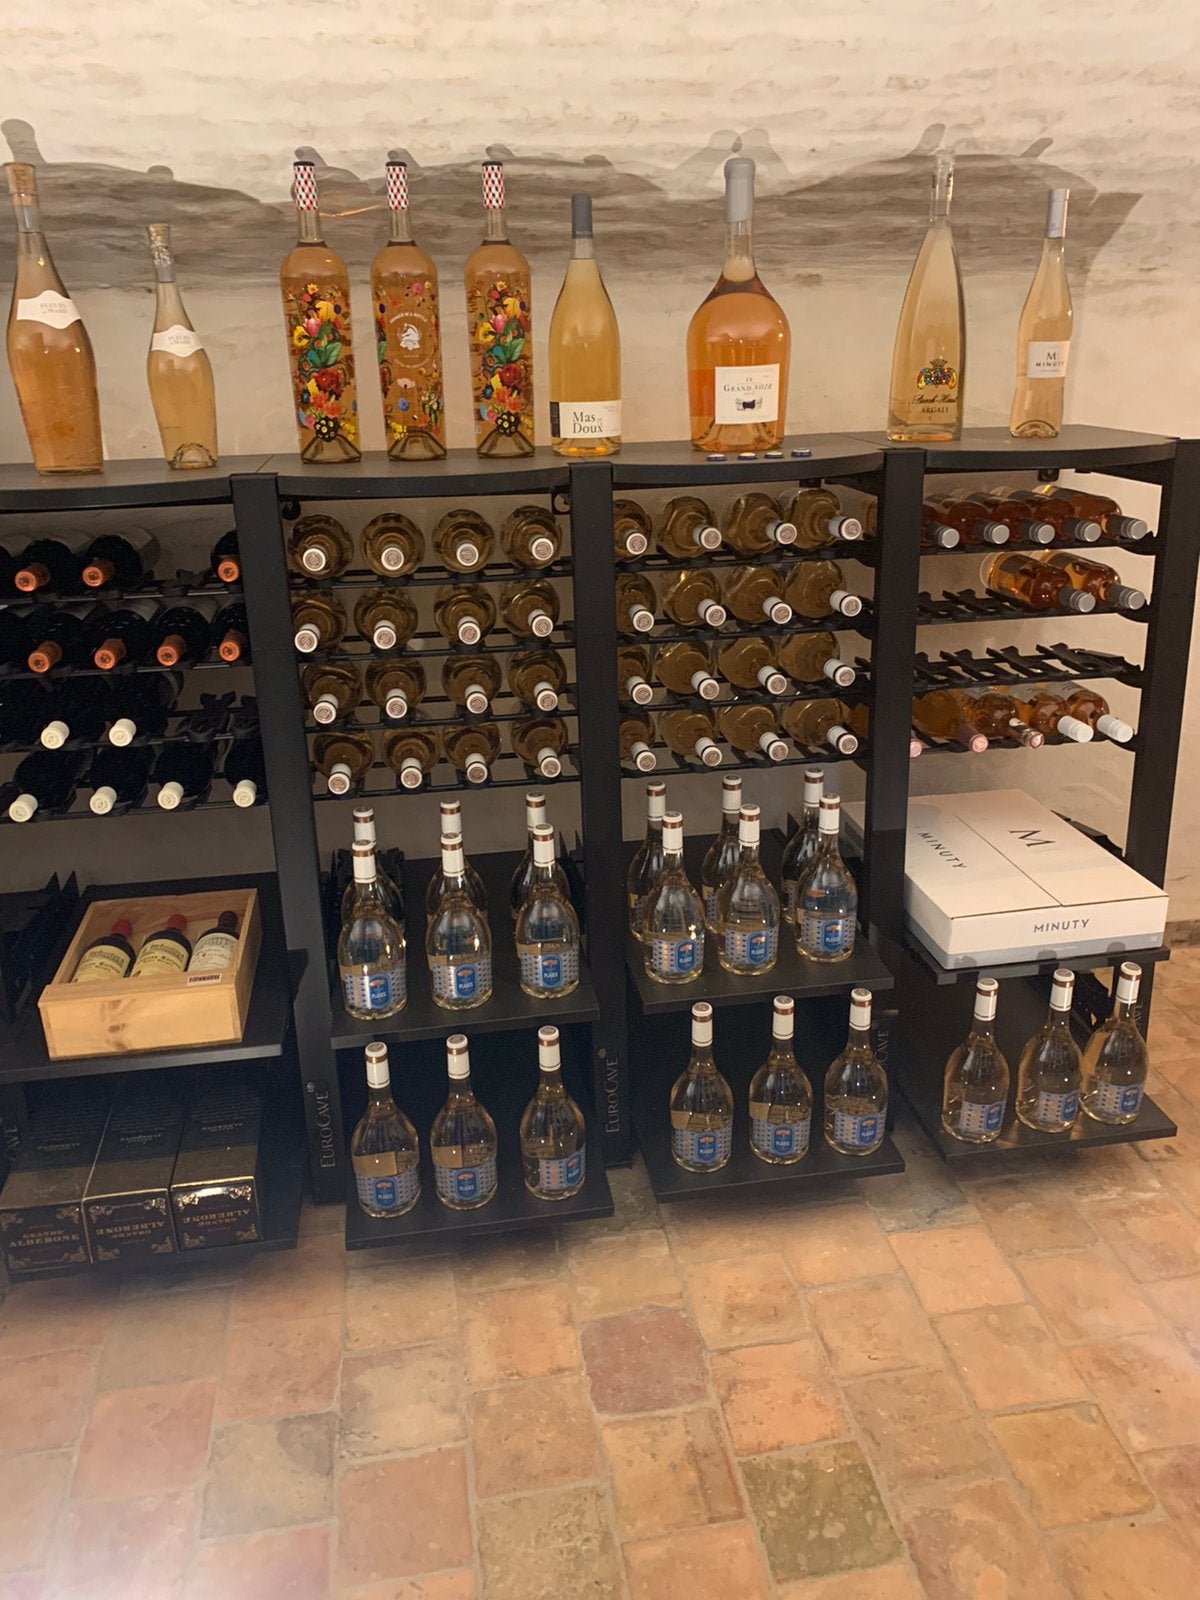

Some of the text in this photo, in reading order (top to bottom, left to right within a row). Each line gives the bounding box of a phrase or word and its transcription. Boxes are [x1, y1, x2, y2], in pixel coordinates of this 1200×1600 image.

[1046, 352, 1056, 361] M
[723, 384, 752, 392] GRAND
[572, 411, 596, 423] Mas
[573, 422, 603, 434] Doux
[1008, 829, 1057, 848] M
[918, 832, 967, 868] MINUTY
[1033, 919, 1090, 933] MINUTY
